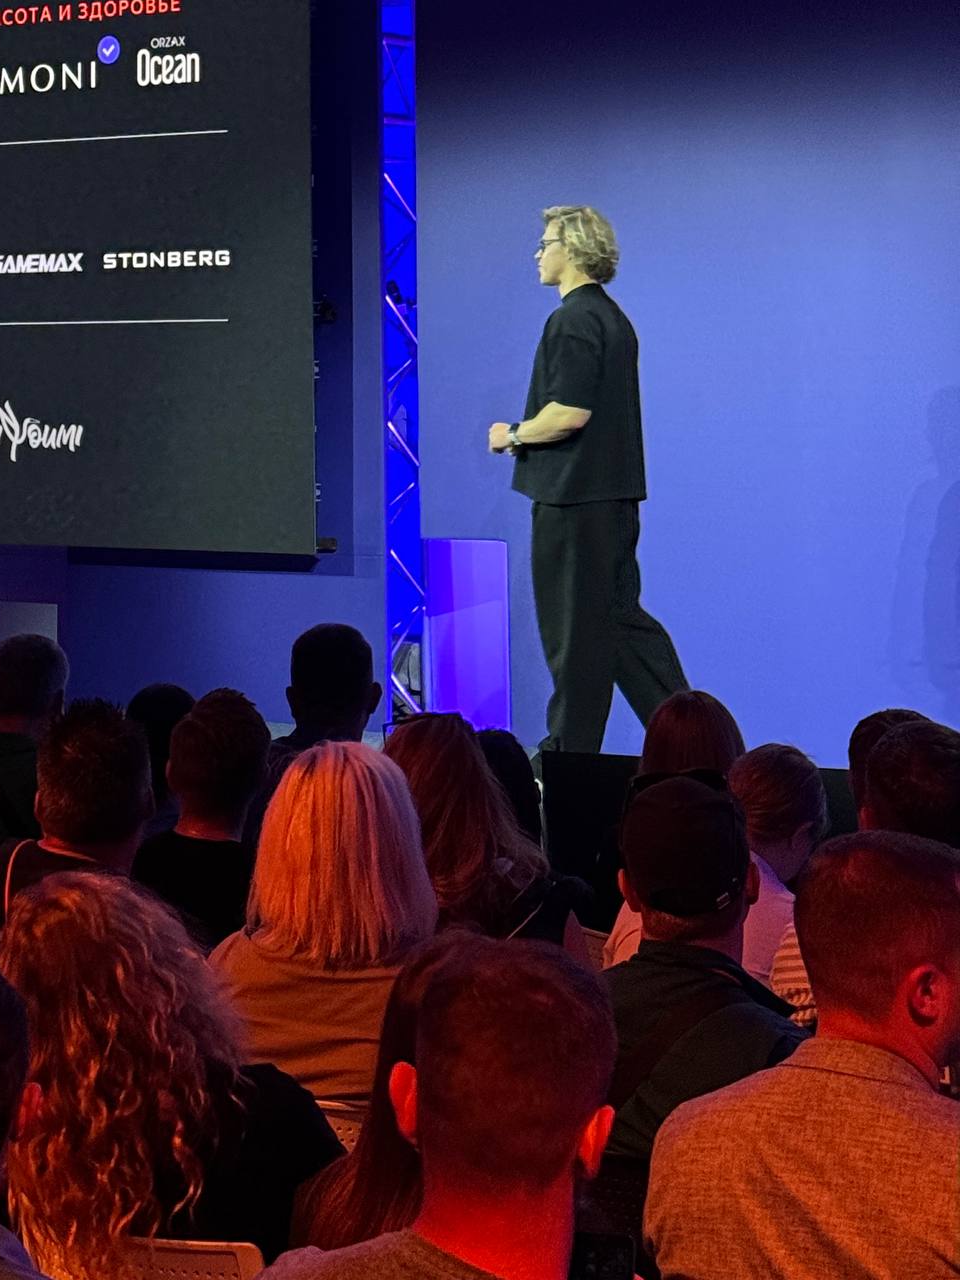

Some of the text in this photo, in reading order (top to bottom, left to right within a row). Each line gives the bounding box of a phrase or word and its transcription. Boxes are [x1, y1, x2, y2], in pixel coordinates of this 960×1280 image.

[58, 4, 72, 22] И
[150, 35, 186, 49] ORZAX
[136, 48, 200, 87] Ocean
[102, 249, 231, 270] STONBERG
